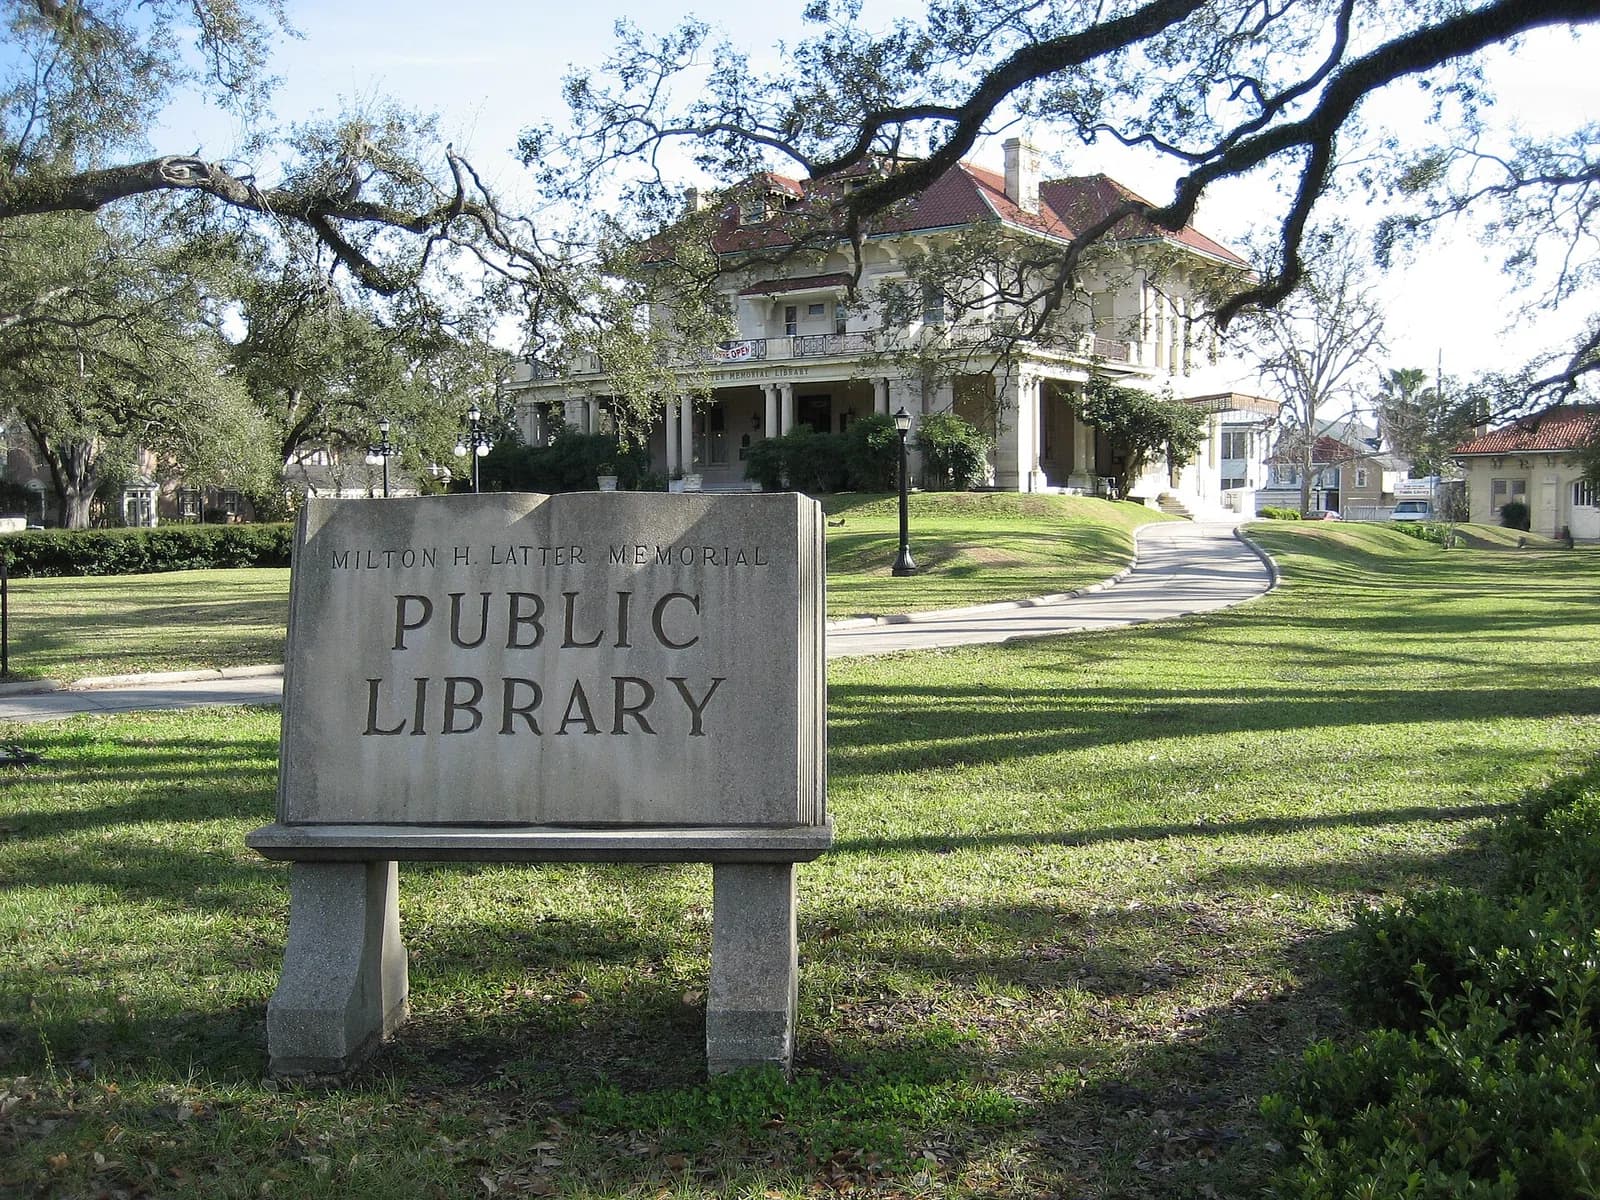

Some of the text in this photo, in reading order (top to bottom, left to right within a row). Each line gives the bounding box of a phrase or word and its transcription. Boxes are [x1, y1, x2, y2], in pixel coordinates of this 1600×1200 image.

[731, 346, 750, 358] OPEN
[729, 370, 769, 379] MEMORIAL
[774, 368, 809, 377] LIBRARY
[331, 545, 769, 569] MILTON H. LATTER MEMORIAL
[391, 591, 700, 650] PUBLIC
[362, 676, 727, 736] LIBRARY
